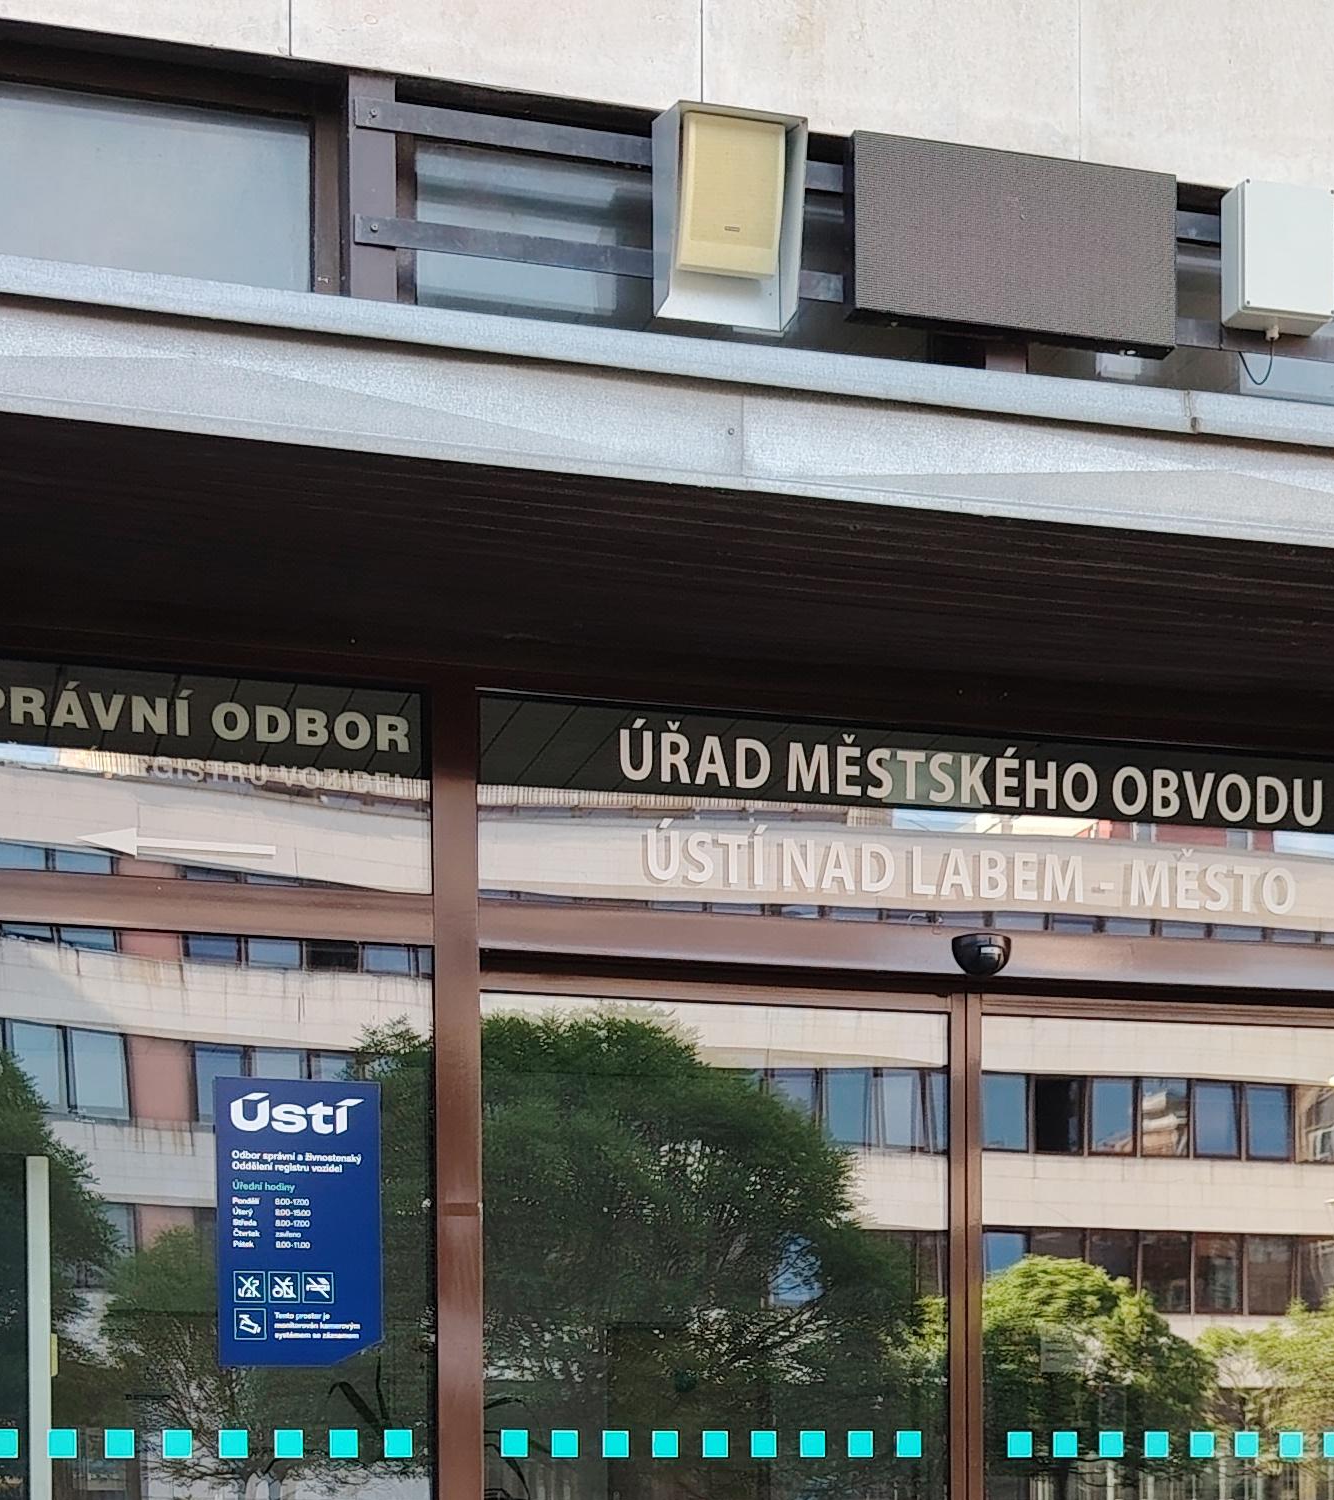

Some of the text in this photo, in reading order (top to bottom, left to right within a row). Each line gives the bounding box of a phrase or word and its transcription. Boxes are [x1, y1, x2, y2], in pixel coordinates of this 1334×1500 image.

[211, 701, 411, 753] ODBOR
[619, 719, 1324, 827] ÚŘAD MĚSTSKÉHO OBVODU
[644, 818, 767, 886] ÚSTÍ
[782, 839, 896, 893] NAD
[912, 845, 1084, 902] LABEM
[1130, 847, 1298, 915] MĚSTO
[230, 1092, 364, 1134] Ústí
[231, 1150, 261, 1160] Odbor
[232, 1161, 343, 1173] Oddělení registru vozidel
[232, 1179, 296, 1193] Úřední hodiny
